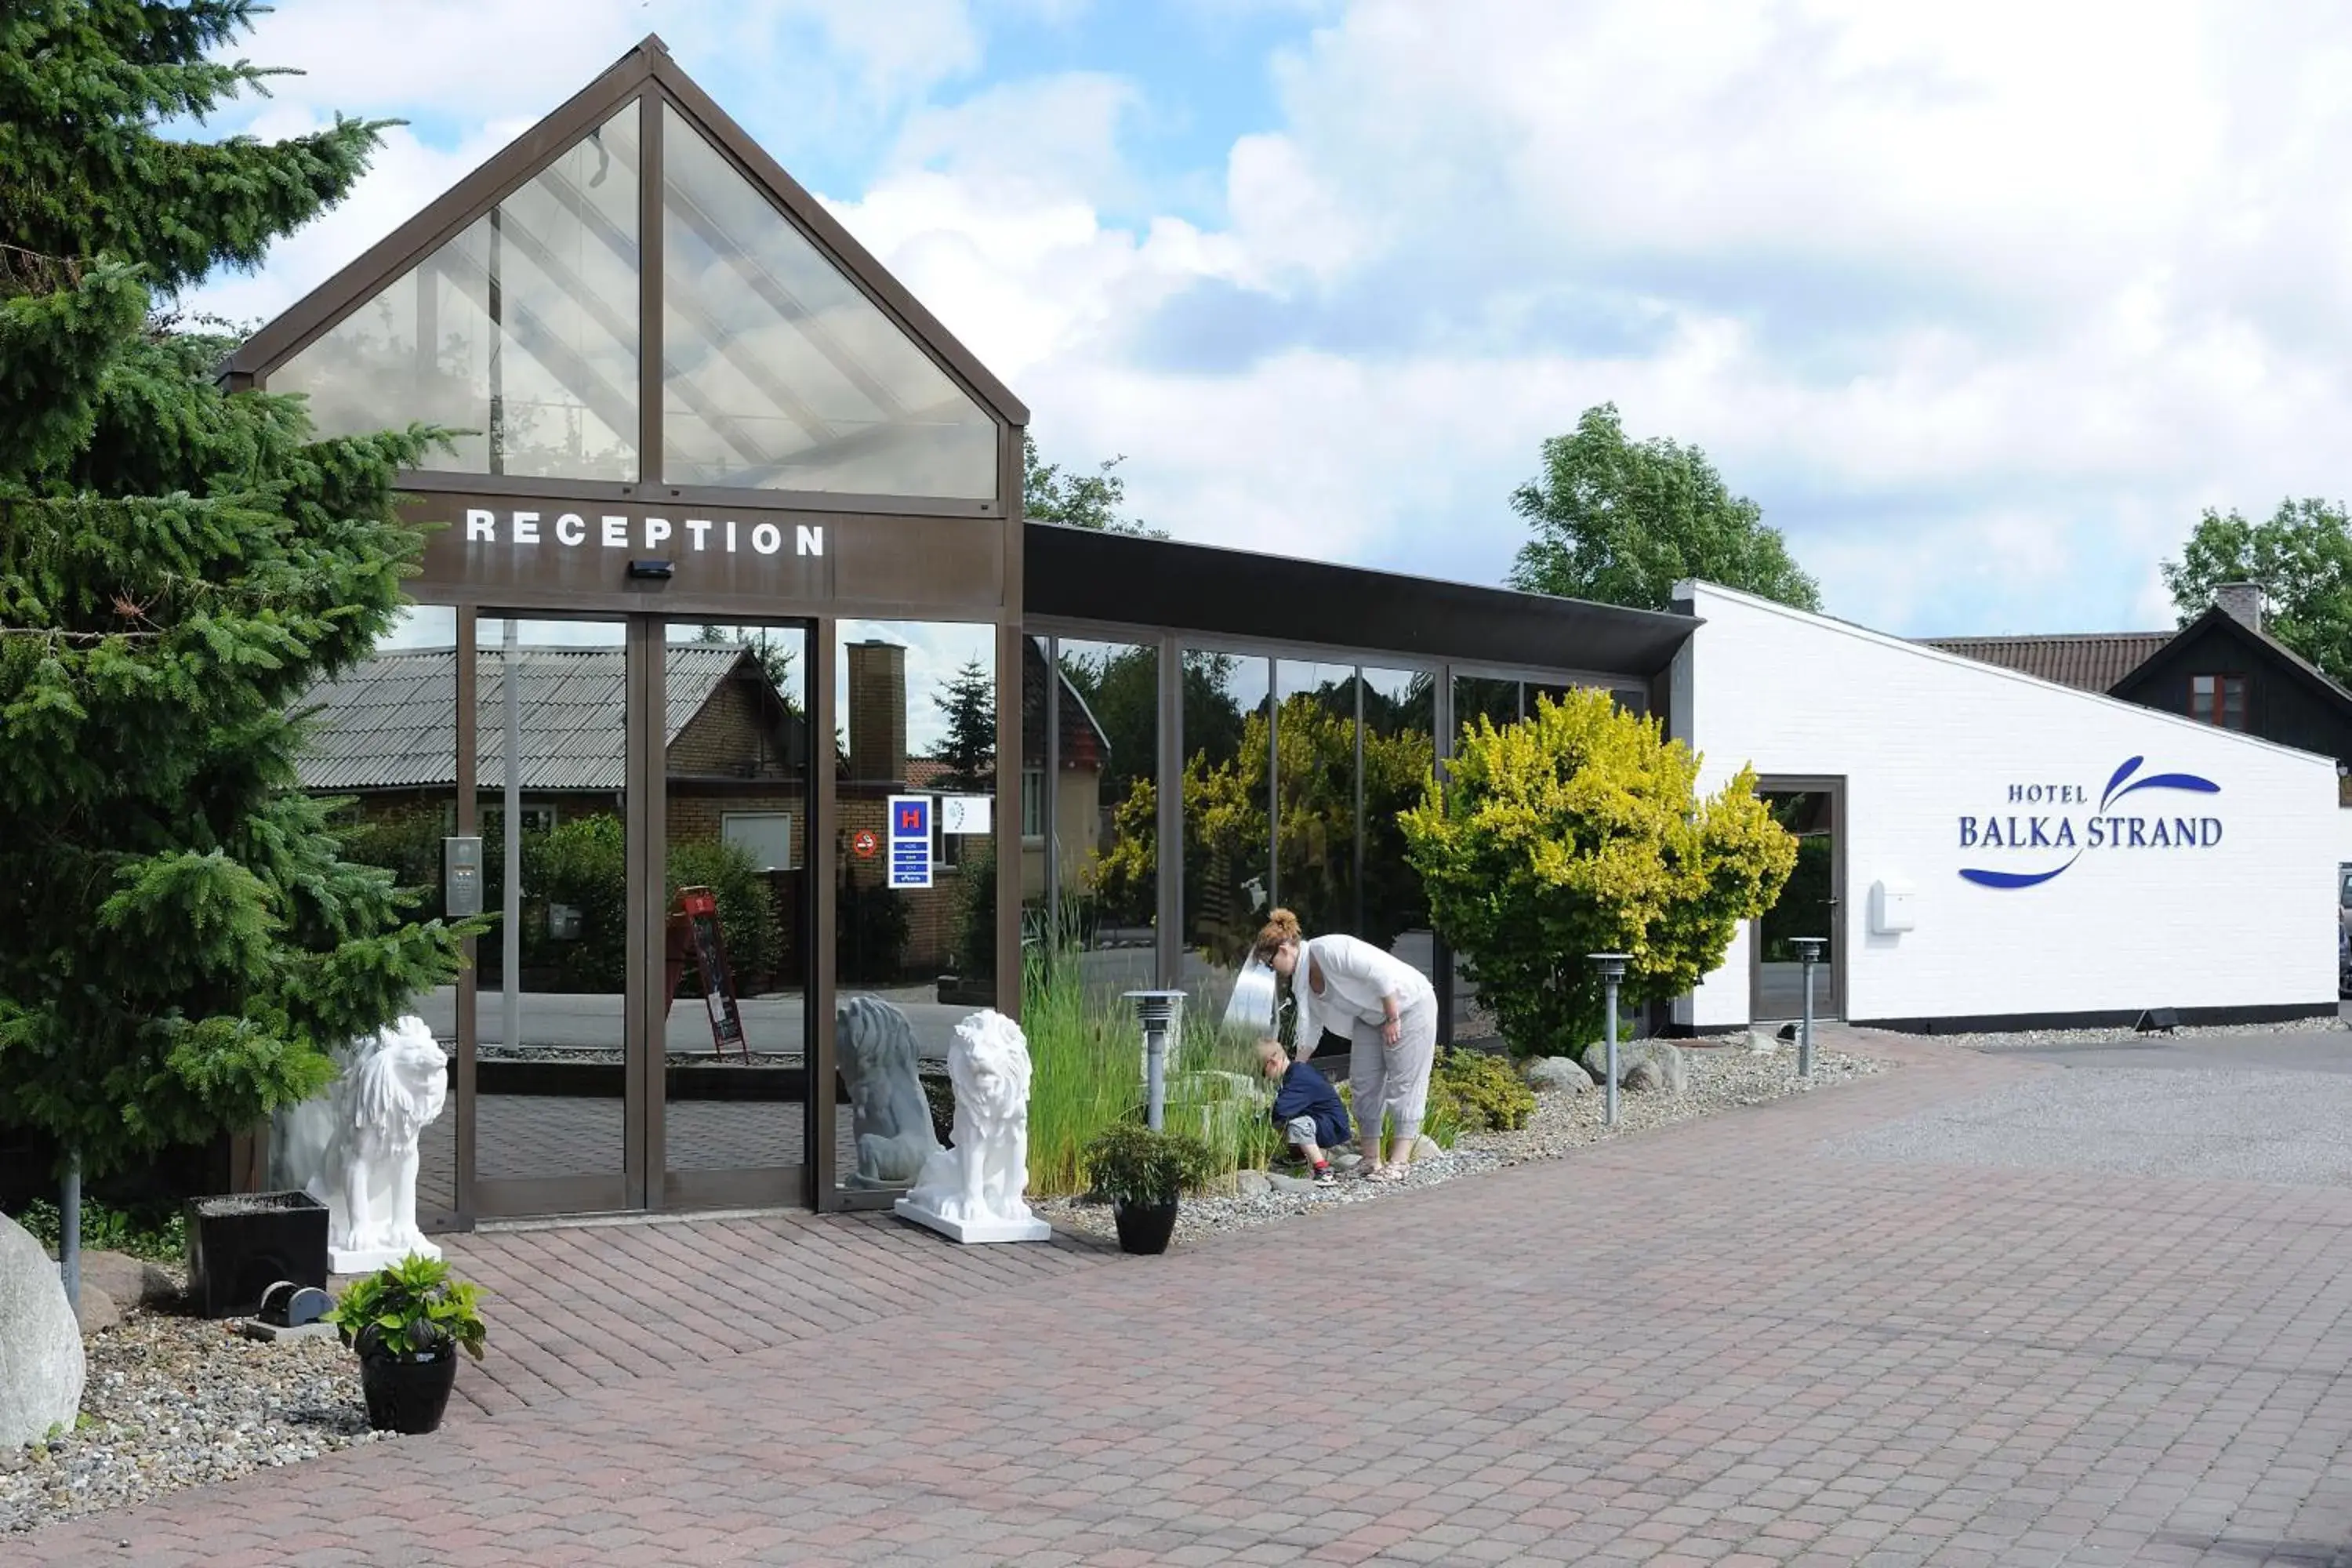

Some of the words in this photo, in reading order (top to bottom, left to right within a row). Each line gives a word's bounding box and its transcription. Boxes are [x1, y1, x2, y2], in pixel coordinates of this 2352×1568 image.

[466, 509, 824, 556] RECEPTION
[2008, 783, 2089, 804] HOTEL
[902, 808, 920, 828] H
[1959, 816, 2077, 848] BALKA
[2087, 816, 2223, 848] STRAND
